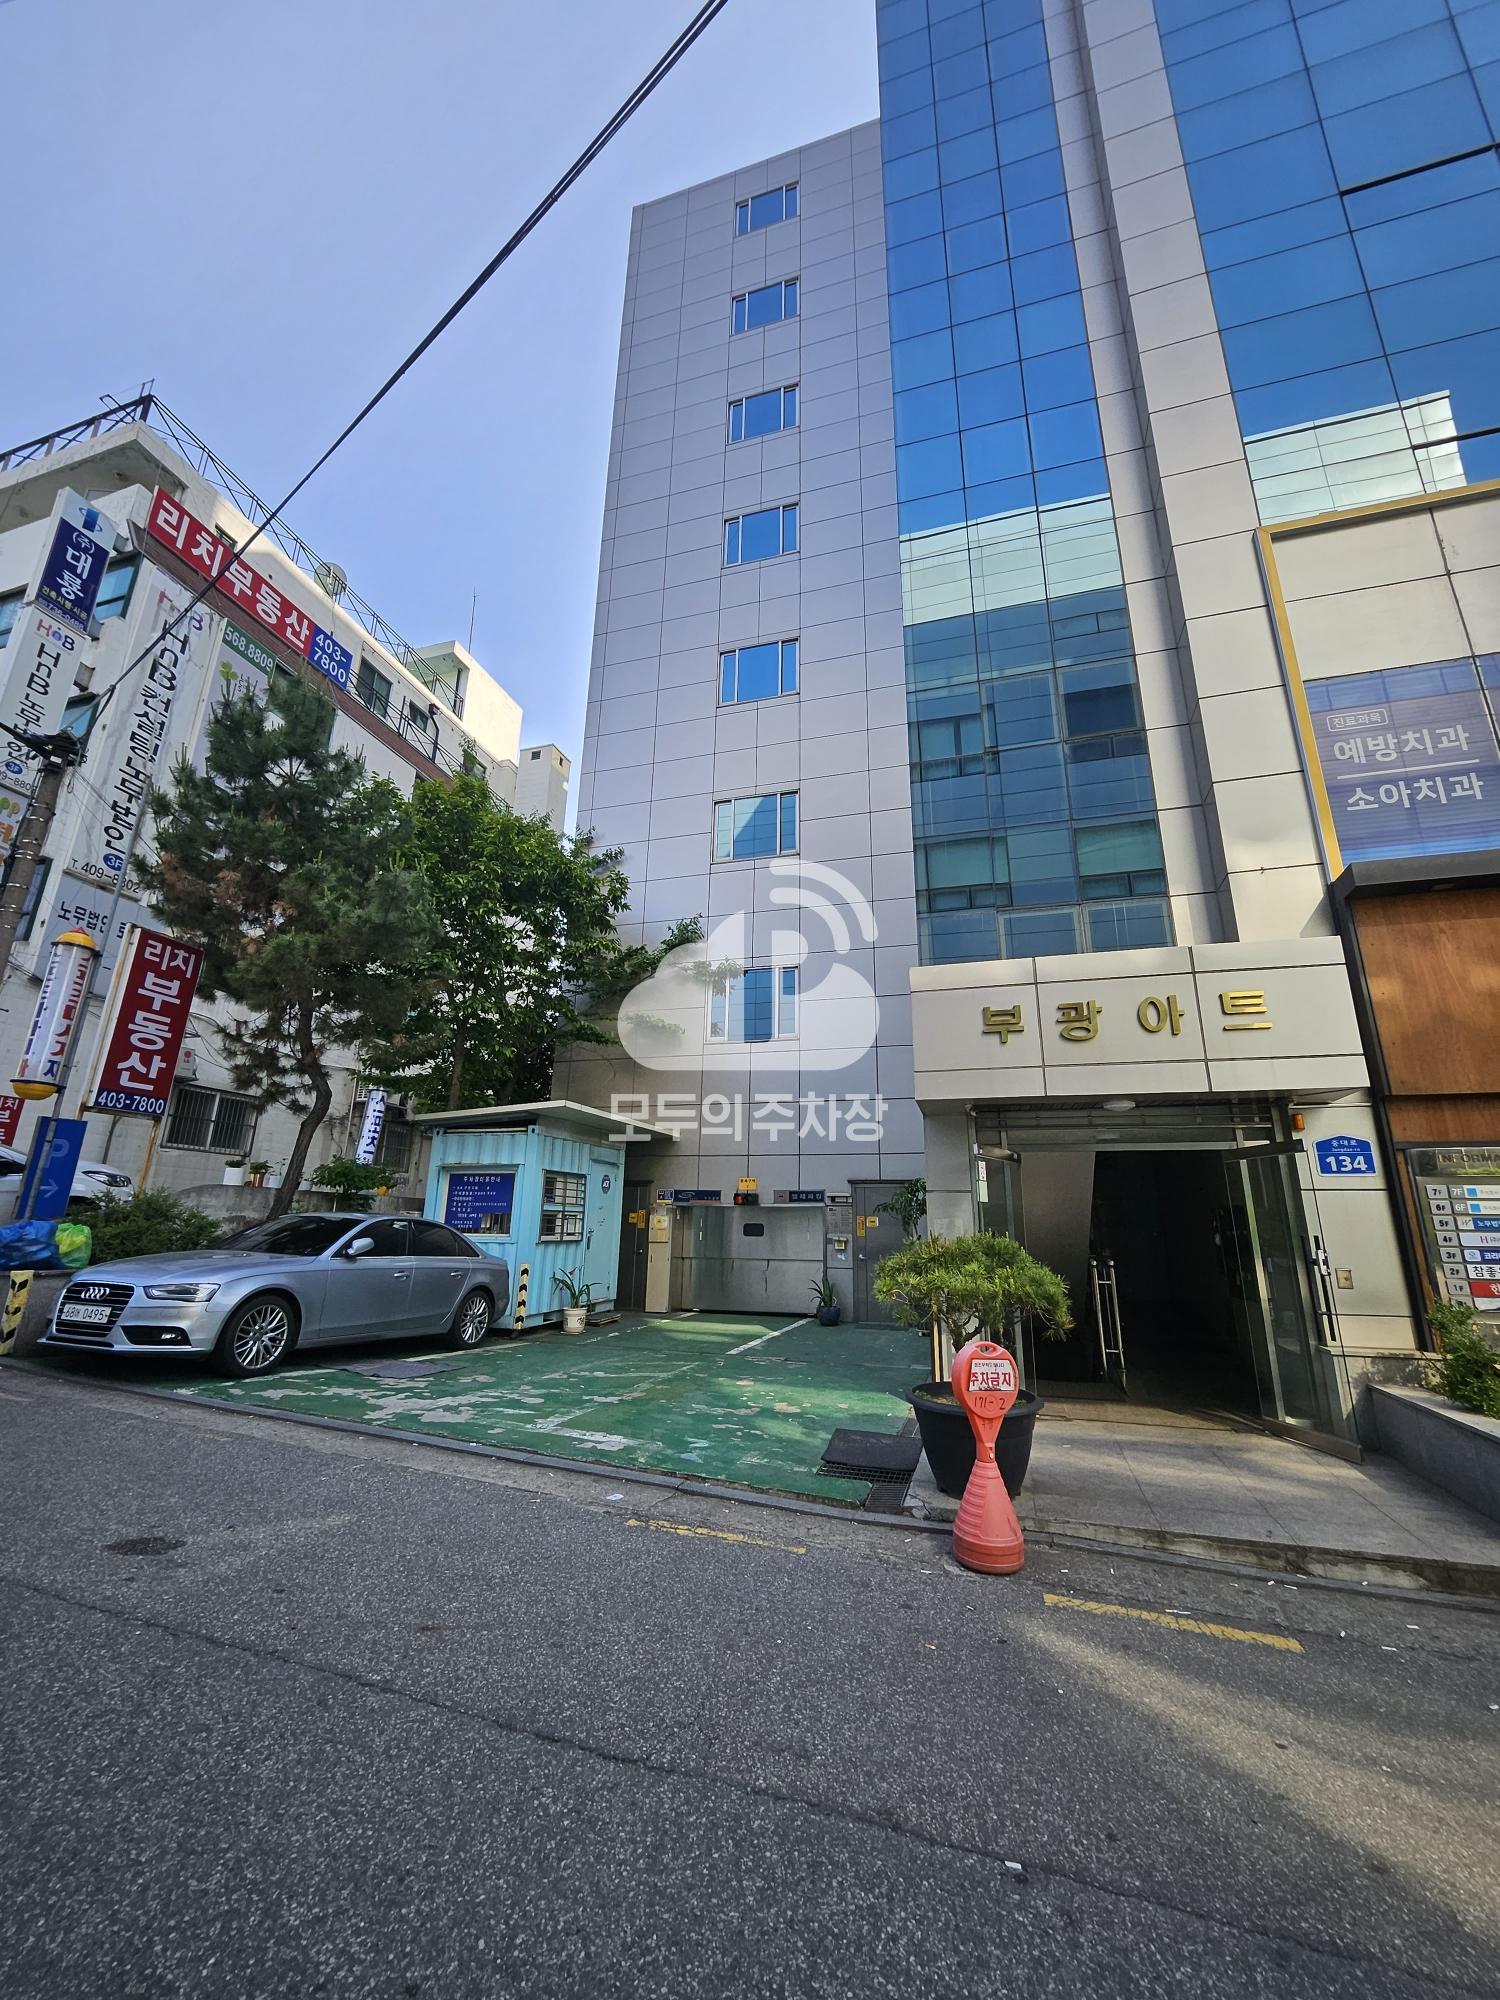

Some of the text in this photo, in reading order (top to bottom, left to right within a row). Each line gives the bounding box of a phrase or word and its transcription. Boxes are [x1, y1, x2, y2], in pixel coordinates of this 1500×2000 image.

[157, 500, 309, 649] 리치부동산
[224, 626, 274, 672] 568.8809
[315, 633, 347, 663] 403-
[313, 646, 346, 683] 7800
[1332, 712, 1381, 728] 진료과목
[1333, 724, 1472, 764] 예방치과
[1346, 772, 1484, 811] 소아치과
[106, 855, 122, 870] 3F
[144, 939, 196, 979] 리치
[981, 989, 1273, 1044] 부광아트
[117, 972, 181, 1091] 부동산
[97, 1090, 165, 1114] 403-7800
[1331, 1139, 1358, 1147] 중대로
[1325, 1155, 1368, 1172] 134
[1431, 1188, 1443, 1196] 7F
[1451, 1188, 1463, 1196] 7F
[1435, 1204, 1446, 1212] 6F
[1455, 1203, 1466, 1212] 6F
[1438, 1219, 1449, 1227] 5F
[1477, 1220, 1500, 1228] 노무법
[1442, 1235, 1453, 1243] 4F
[1445, 1251, 1456, 1259] 3F
[1449, 1267, 1460, 1276] 2F
[82, 1308, 105, 1321] 0495
[970, 1371, 1011, 1387] 주차금지
